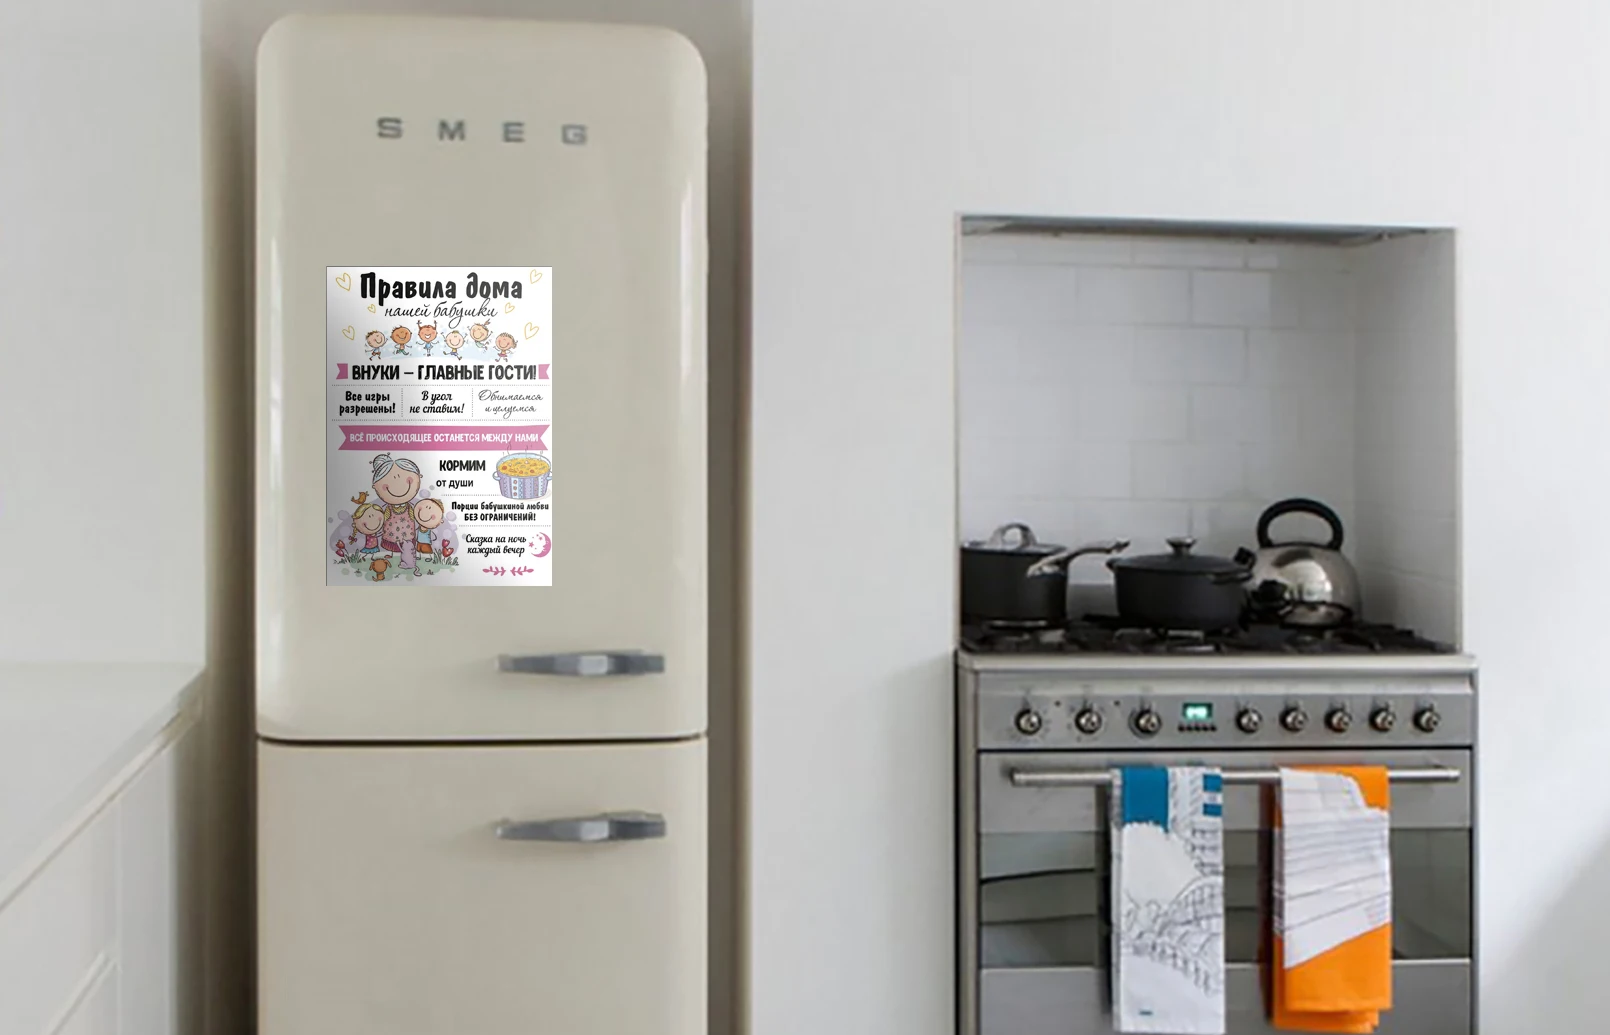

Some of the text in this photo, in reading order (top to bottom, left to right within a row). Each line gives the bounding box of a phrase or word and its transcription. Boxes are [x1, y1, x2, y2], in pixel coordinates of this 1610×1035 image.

[376, 116, 587, 145] SMEG
[360, 272, 522, 306] Правила дома
[384, 298, 498, 329] нашей бабушки
[352, 365, 400, 380] ВНУКИ
[417, 365, 484, 380] ГЛАВНЫЕ
[488, 365, 537, 380] ГОСТИ!
[345, 391, 390, 405] Все игры
[421, 390, 453, 405] В угол
[478, 389, 544, 401] Обнимаемся
[339, 403, 396, 416] разрешены!
[409, 403, 465, 414] не ставим!
[492, 406, 537, 419] целуемся
[350, 432, 539, 443] ВСЁ ПРОИСХОДЯЩЕЕ ОСТАНЕТСЯ МЕЖДУ НАМИ
[439, 460, 486, 471] КОРМИМ
[448, 480, 474, 489] души
[451, 501, 549, 512] Порции бабушкиной любви
[464, 512, 536, 521] БЕЗ ОГРАНИЧЕНИЙ!
[465, 533, 494, 546] Сказка
[467, 545, 525, 557] каждый вечер
